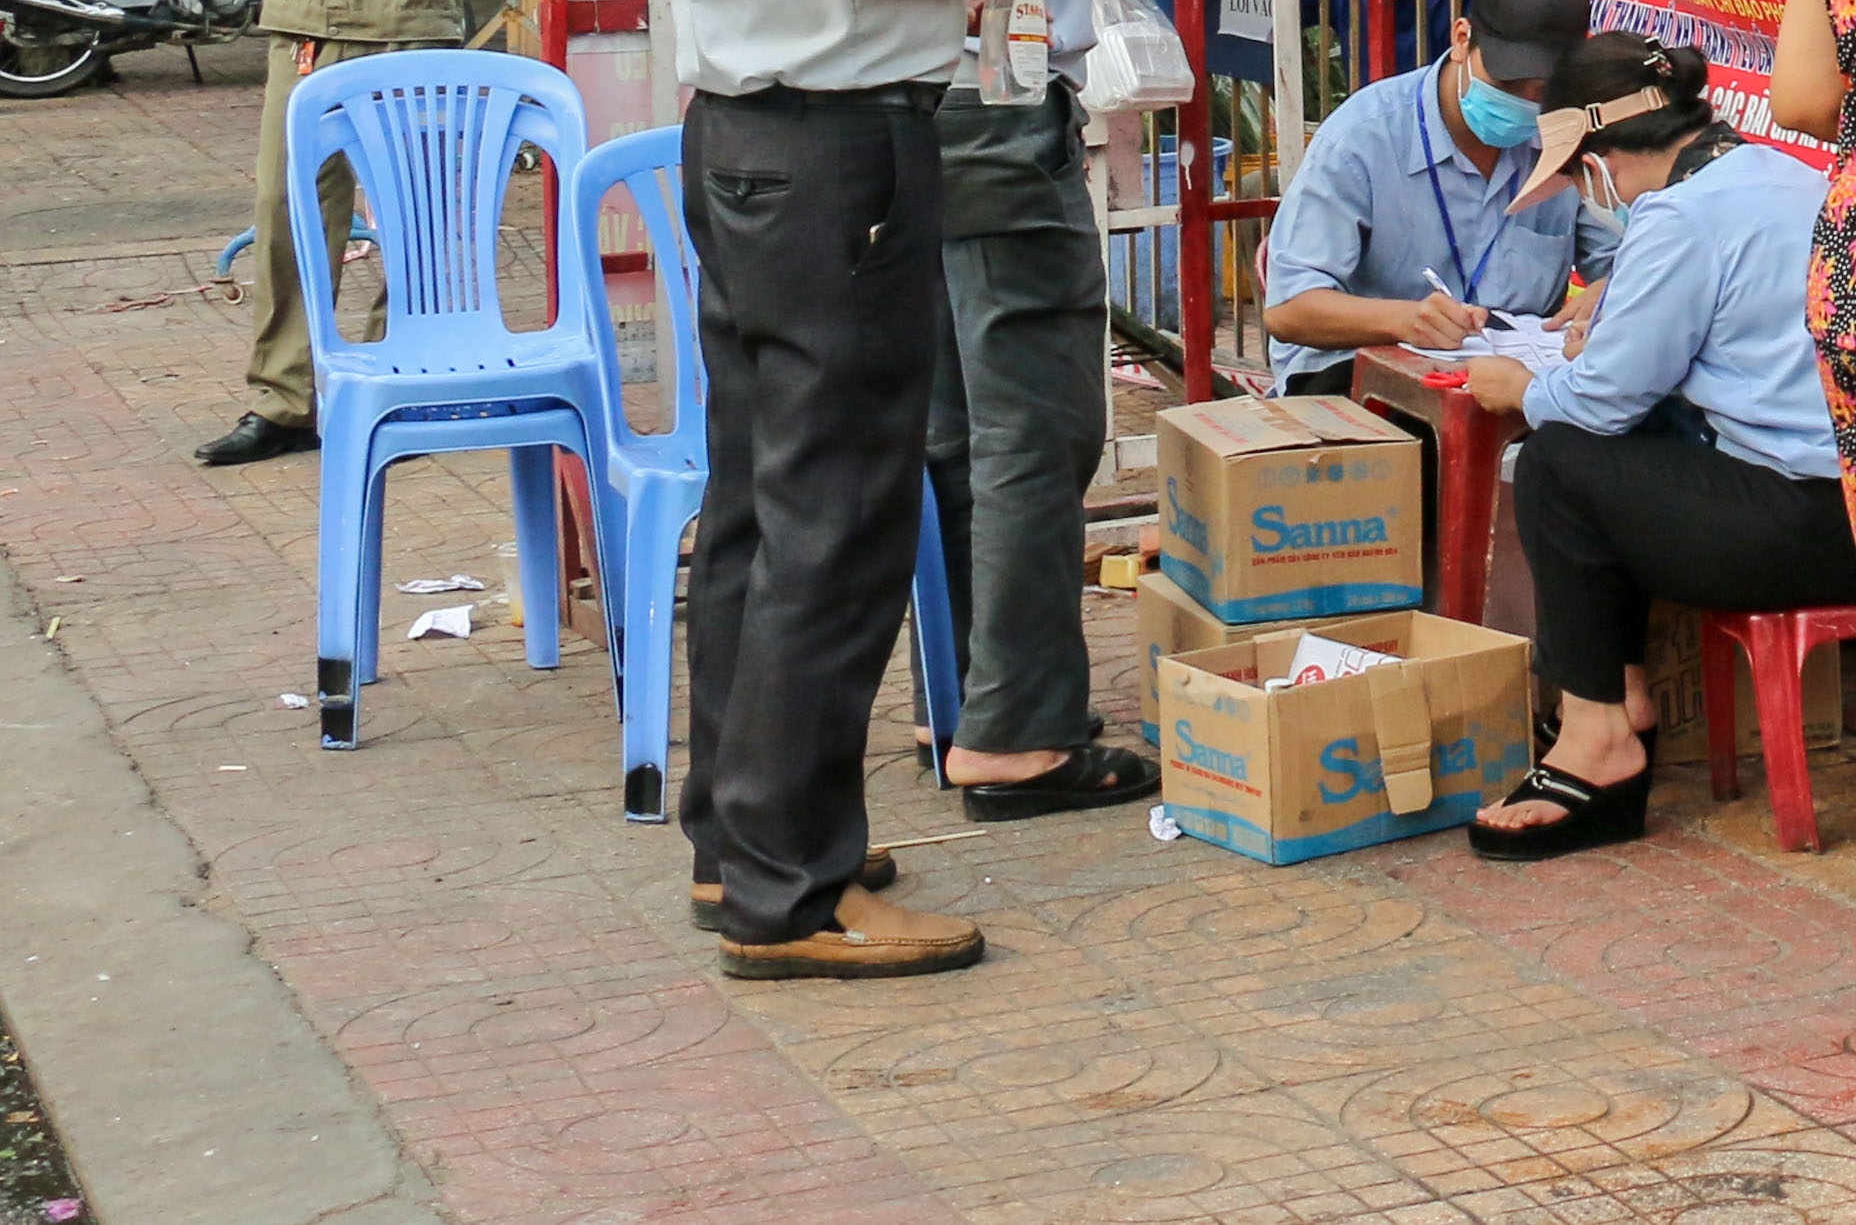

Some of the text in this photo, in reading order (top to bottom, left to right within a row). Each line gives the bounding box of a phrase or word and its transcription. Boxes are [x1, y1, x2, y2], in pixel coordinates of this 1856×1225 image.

[1251, 504, 1388, 554] Sanna
[1174, 718, 1248, 781] Sanna
[1318, 736, 1478, 805] Sana
